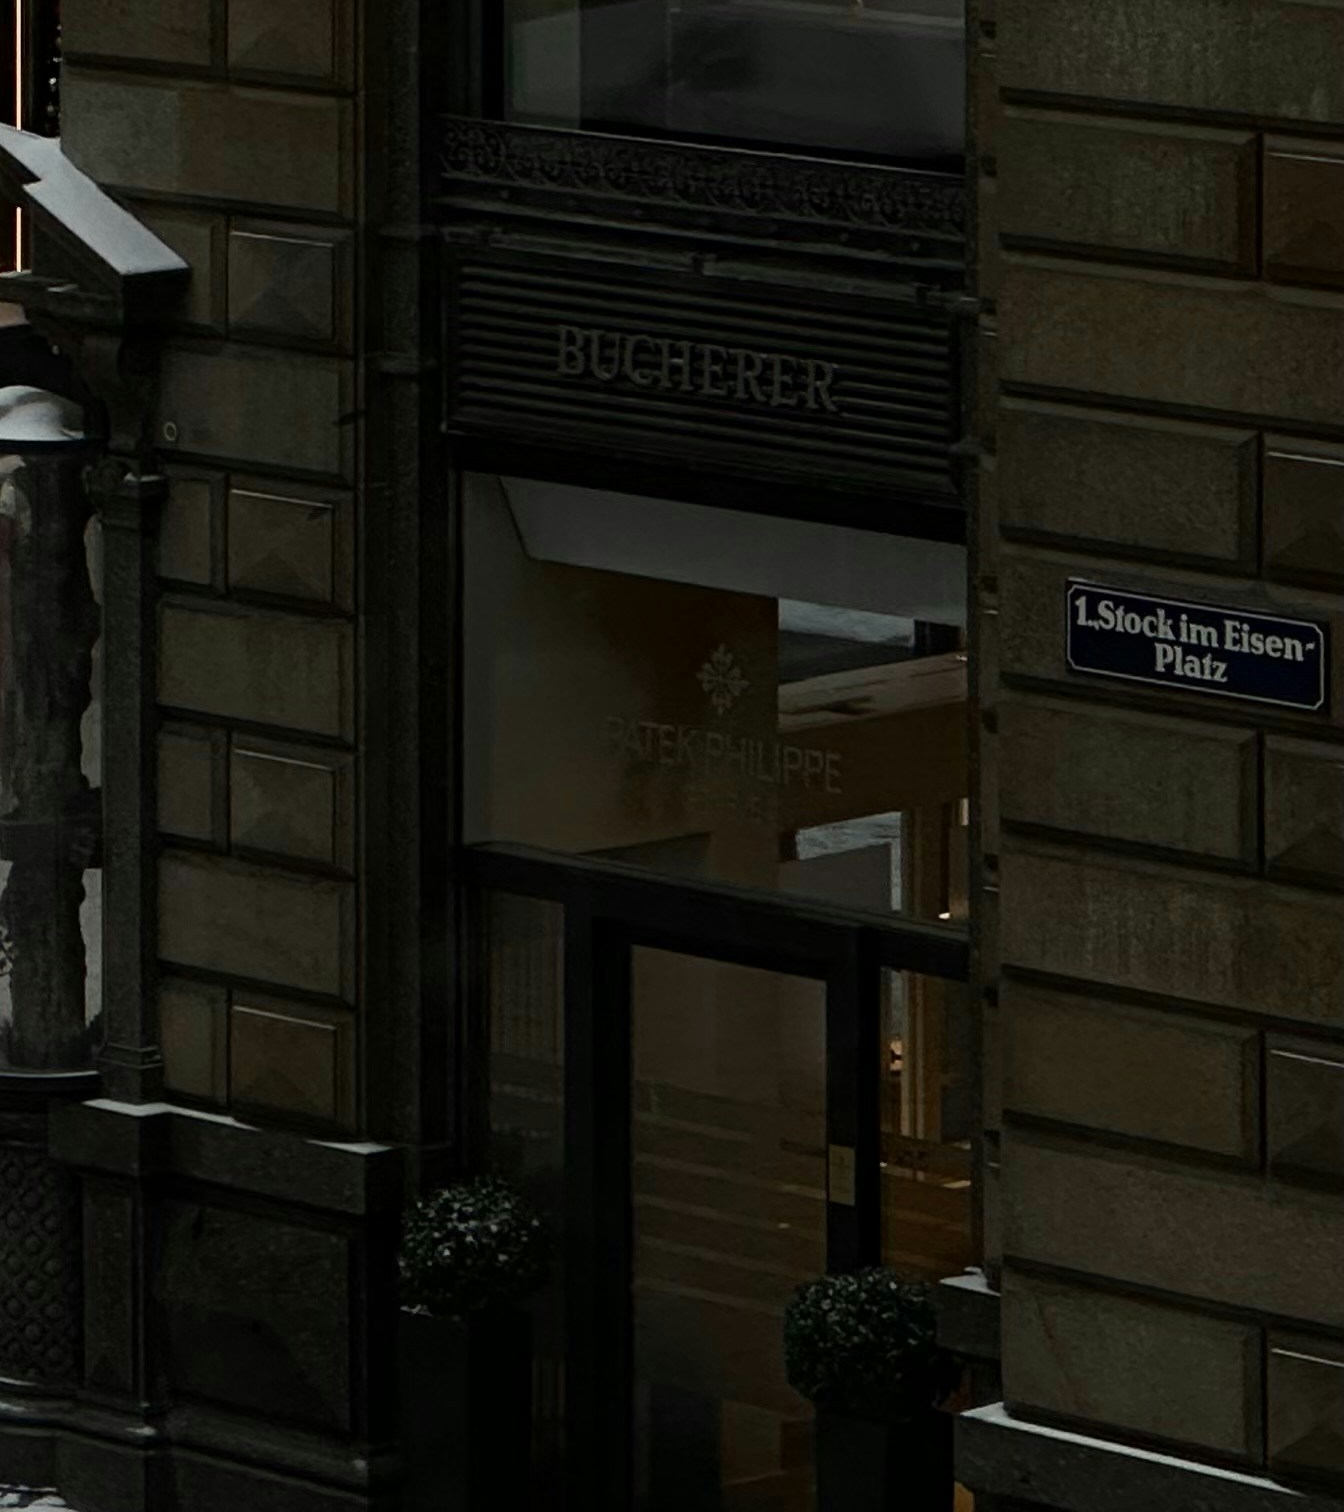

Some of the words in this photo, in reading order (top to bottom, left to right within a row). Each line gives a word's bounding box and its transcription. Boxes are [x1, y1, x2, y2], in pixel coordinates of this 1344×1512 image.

[555, 323, 842, 413] BUCHERER
[1154, 641, 1229, 684] Platz
[1178, 613, 1219, 649] im
[1222, 618, 1316, 663] Eisen-
[704, 730, 844, 795] PHILIPPE
